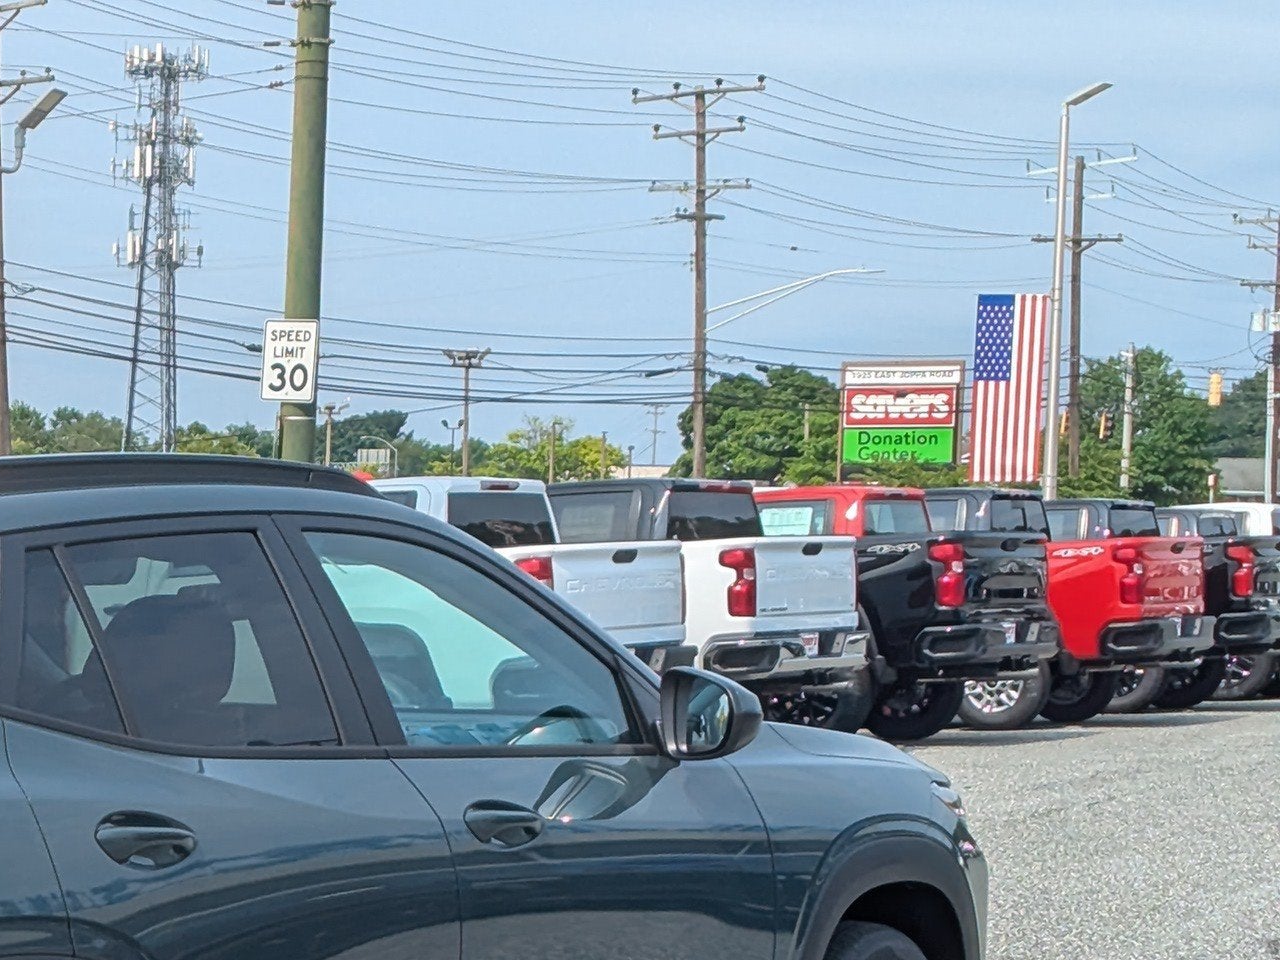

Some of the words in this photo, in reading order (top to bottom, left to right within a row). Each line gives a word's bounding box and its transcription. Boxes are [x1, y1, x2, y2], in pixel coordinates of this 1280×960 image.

[270, 329, 312, 342] SPEED
[273, 346, 306, 358] LIMIT
[268, 363, 308, 392] 30
[874, 370, 896, 379] EAST
[929, 370, 954, 379] ROAD
[858, 431, 938, 445] Donation
[857, 446, 918, 461] Center
